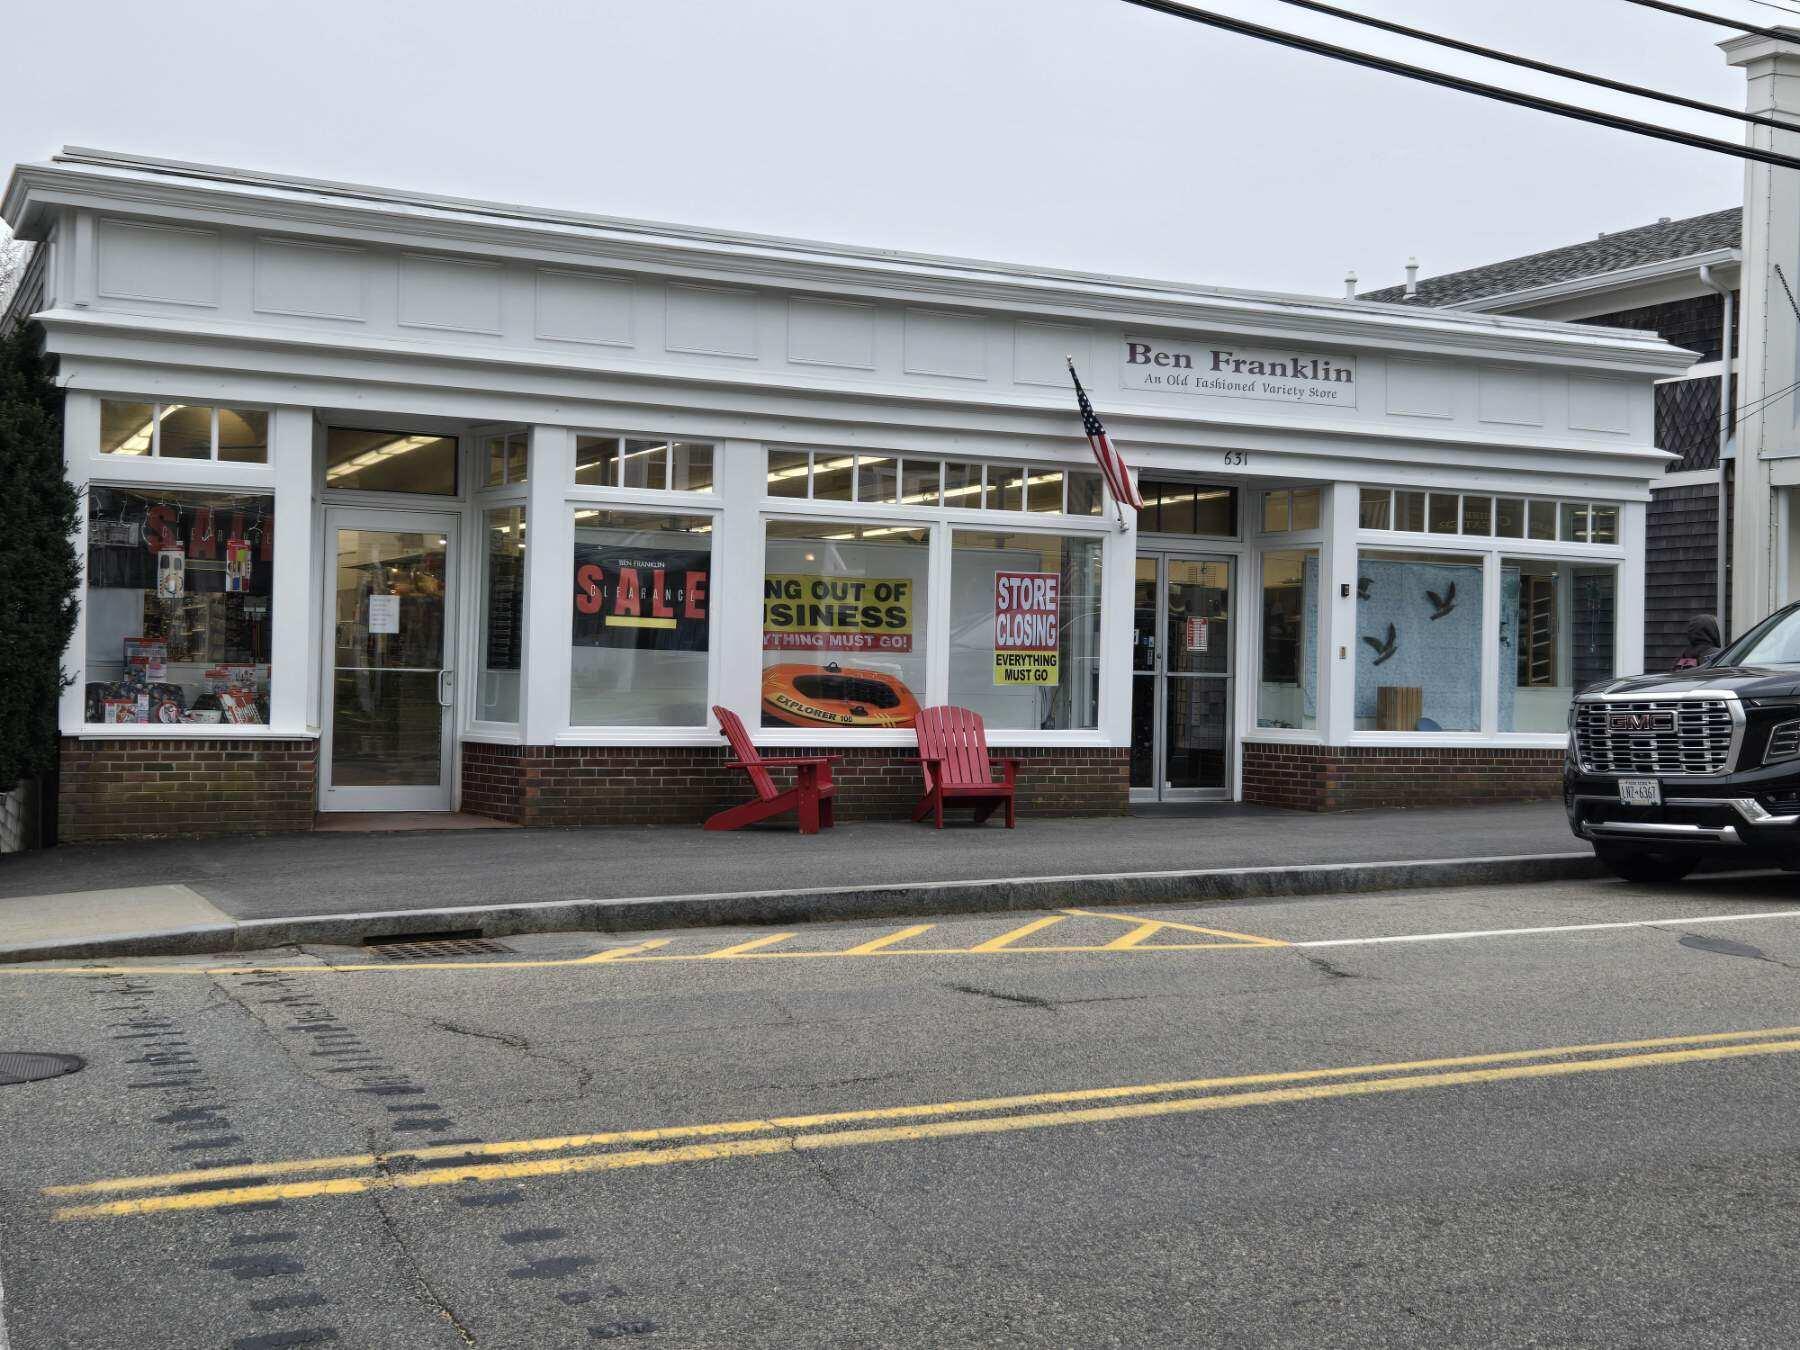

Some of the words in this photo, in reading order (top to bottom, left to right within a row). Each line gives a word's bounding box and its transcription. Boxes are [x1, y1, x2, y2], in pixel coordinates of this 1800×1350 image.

[1126, 342, 1193, 369] Ben
[1209, 350, 1353, 383] Franklin
[1144, 373, 1161, 384] An
[1166, 374, 1189, 386] Old
[1195, 377, 1257, 392] Fashioned
[1262, 382, 1305, 400] Variety
[1308, 387, 1337, 399] Store
[1224, 450, 1248, 466] 631
[633, 560, 665, 568] FRANKLIN
[576, 564, 707, 618] SALE
[590, 584, 695, 602] CLEARANCE
[811, 580, 866, 602] OUT
[874, 582, 908, 602] OF
[998, 576, 1057, 611] STORE
[763, 603, 907, 628] SINESS
[829, 633, 875, 648] MUST
[879, 635, 908, 648] GO!
[996, 614, 1056, 647] CLOSING
[995, 654, 1057, 667] EVERYTHING
[1004, 669, 1031, 681] MUST
[1034, 669, 1048, 681] GO
[776, 694, 837, 721] EXPLORER
[1609, 714, 1672, 730] GMC
